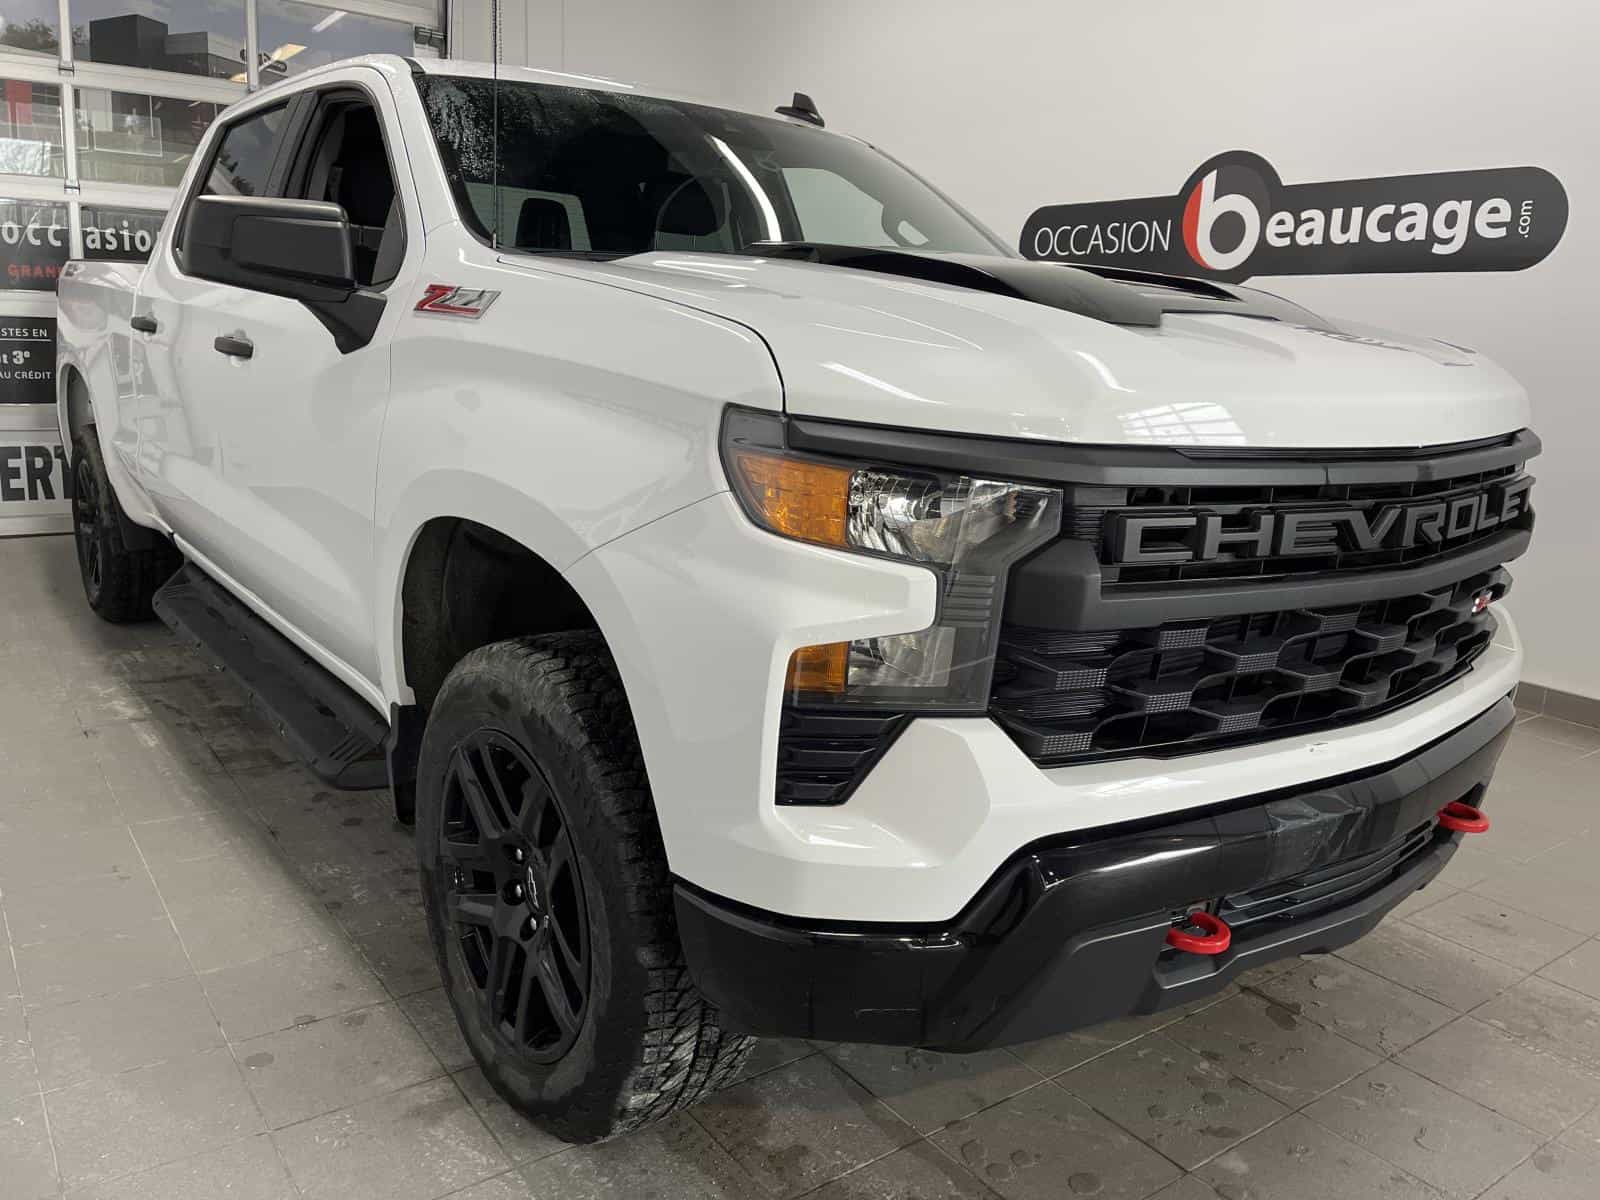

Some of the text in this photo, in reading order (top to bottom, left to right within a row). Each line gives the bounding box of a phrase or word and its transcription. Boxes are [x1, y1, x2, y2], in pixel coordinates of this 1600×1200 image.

[1, 219, 161, 253] occasio
[1034, 219, 1172, 257] OCCASION
[414, 283, 502, 320] Z71
[0, 327, 48, 337] STES EN
[14, 369, 52, 380] CRÉDIT
